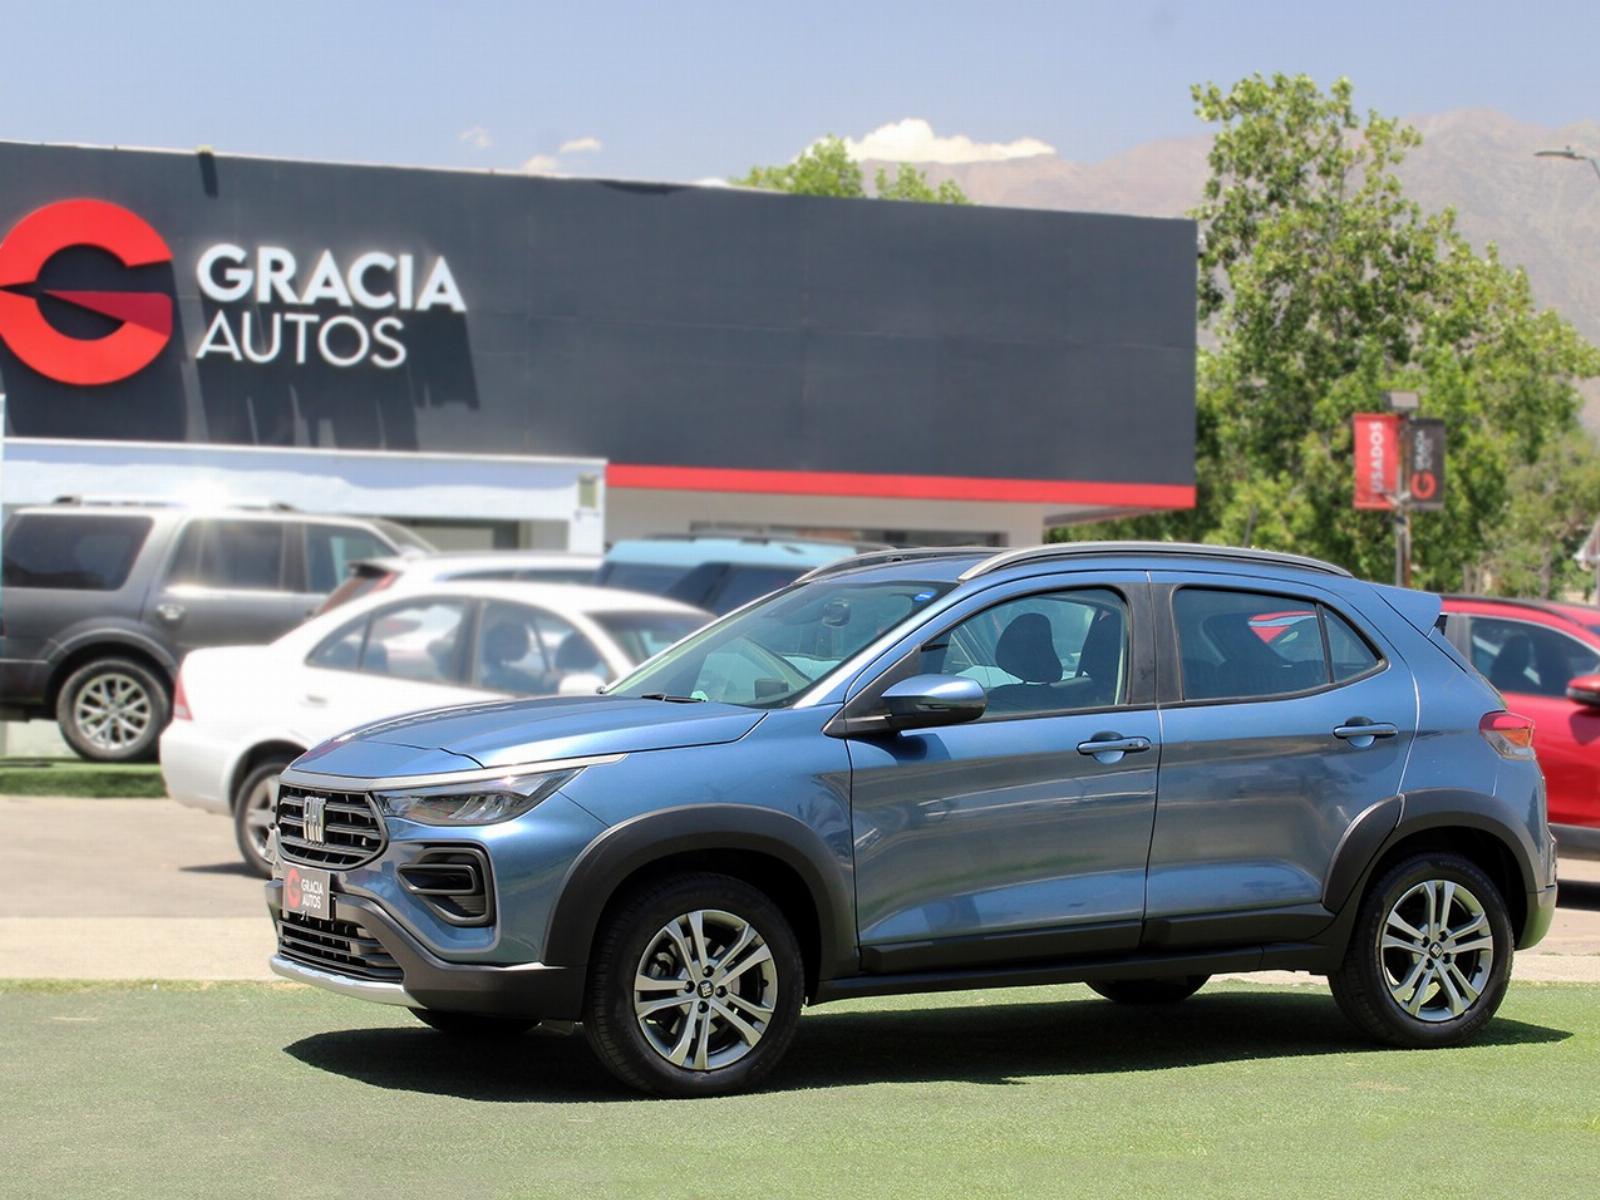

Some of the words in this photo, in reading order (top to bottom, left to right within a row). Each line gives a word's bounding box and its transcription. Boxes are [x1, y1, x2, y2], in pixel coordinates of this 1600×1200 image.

[197, 243, 467, 312] GRACIA
[196, 310, 407, 368] AUTOS
[301, 878, 324, 896] GRACIA
[302, 894, 322, 910] AUTOS
